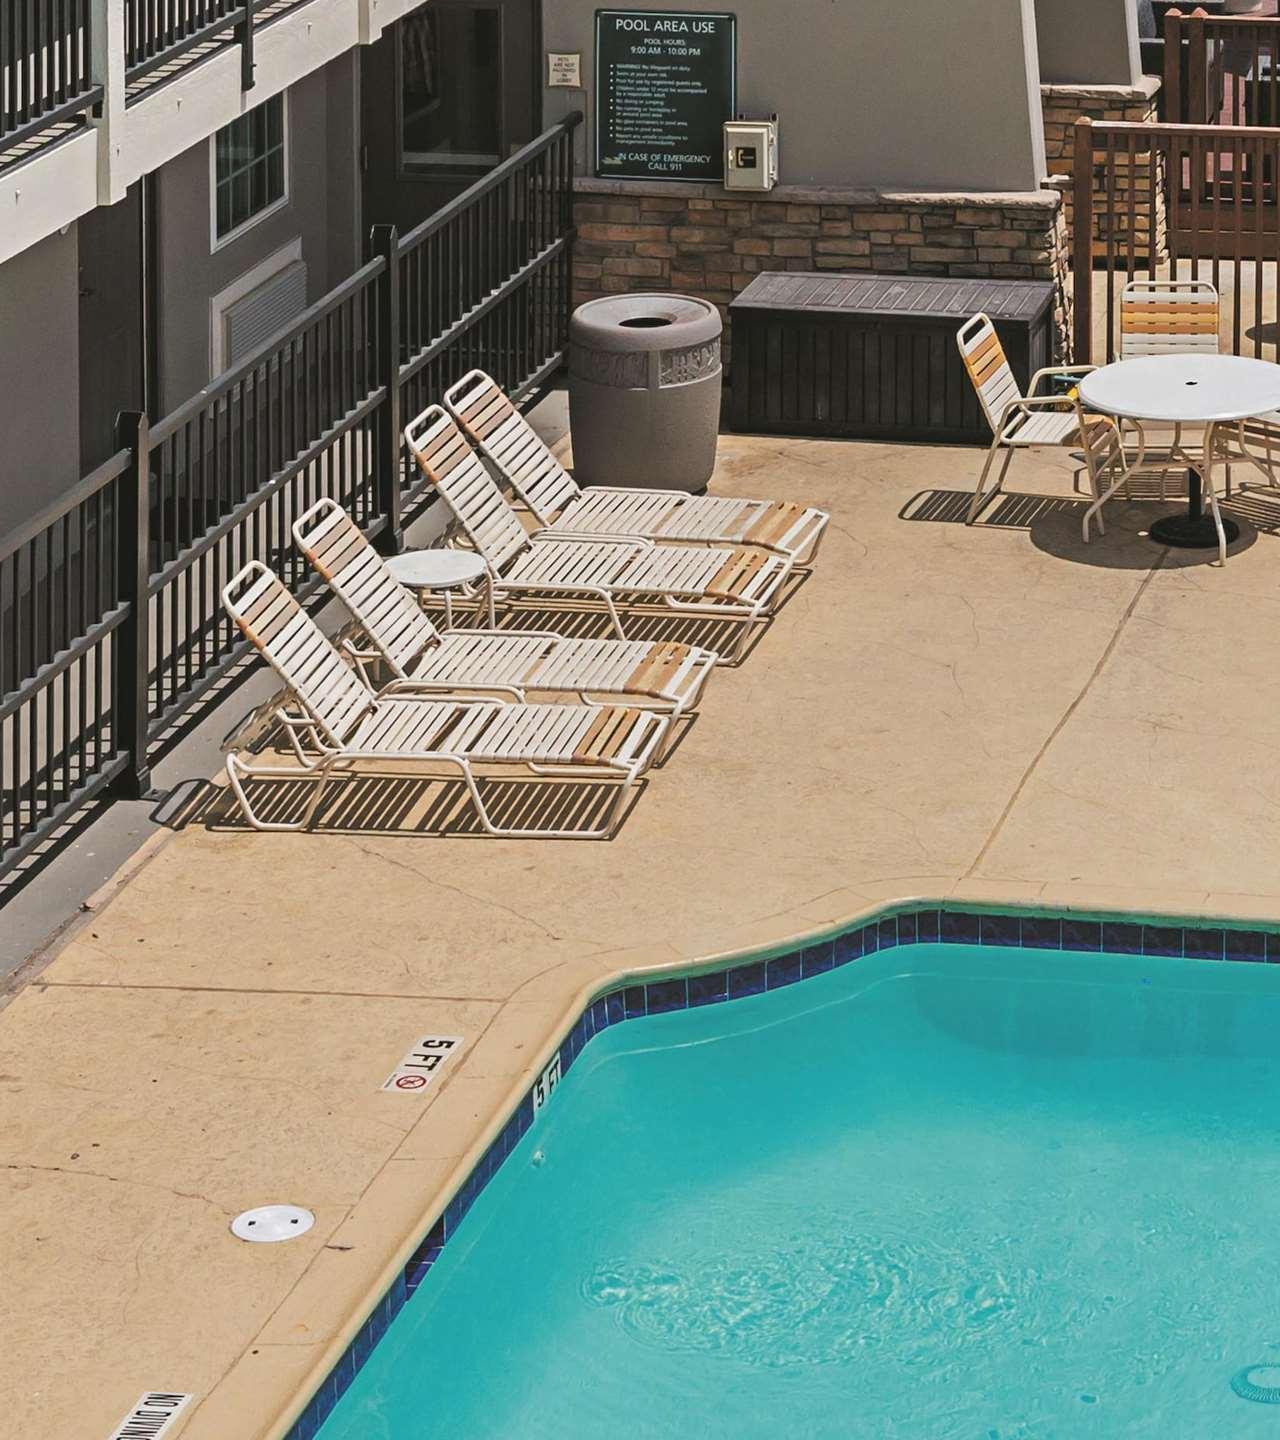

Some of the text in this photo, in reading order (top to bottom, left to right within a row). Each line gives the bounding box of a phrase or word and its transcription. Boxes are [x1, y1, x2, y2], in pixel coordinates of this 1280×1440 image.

[616, 19, 715, 33] POOL AREA USE
[629, 153, 648, 162] CASE
[664, 154, 711, 163] EMERGENCY
[405, 1039, 455, 1071] 5 FT
[537, 1058, 559, 1108] 5 FT
[143, 1394, 186, 1407] NO
